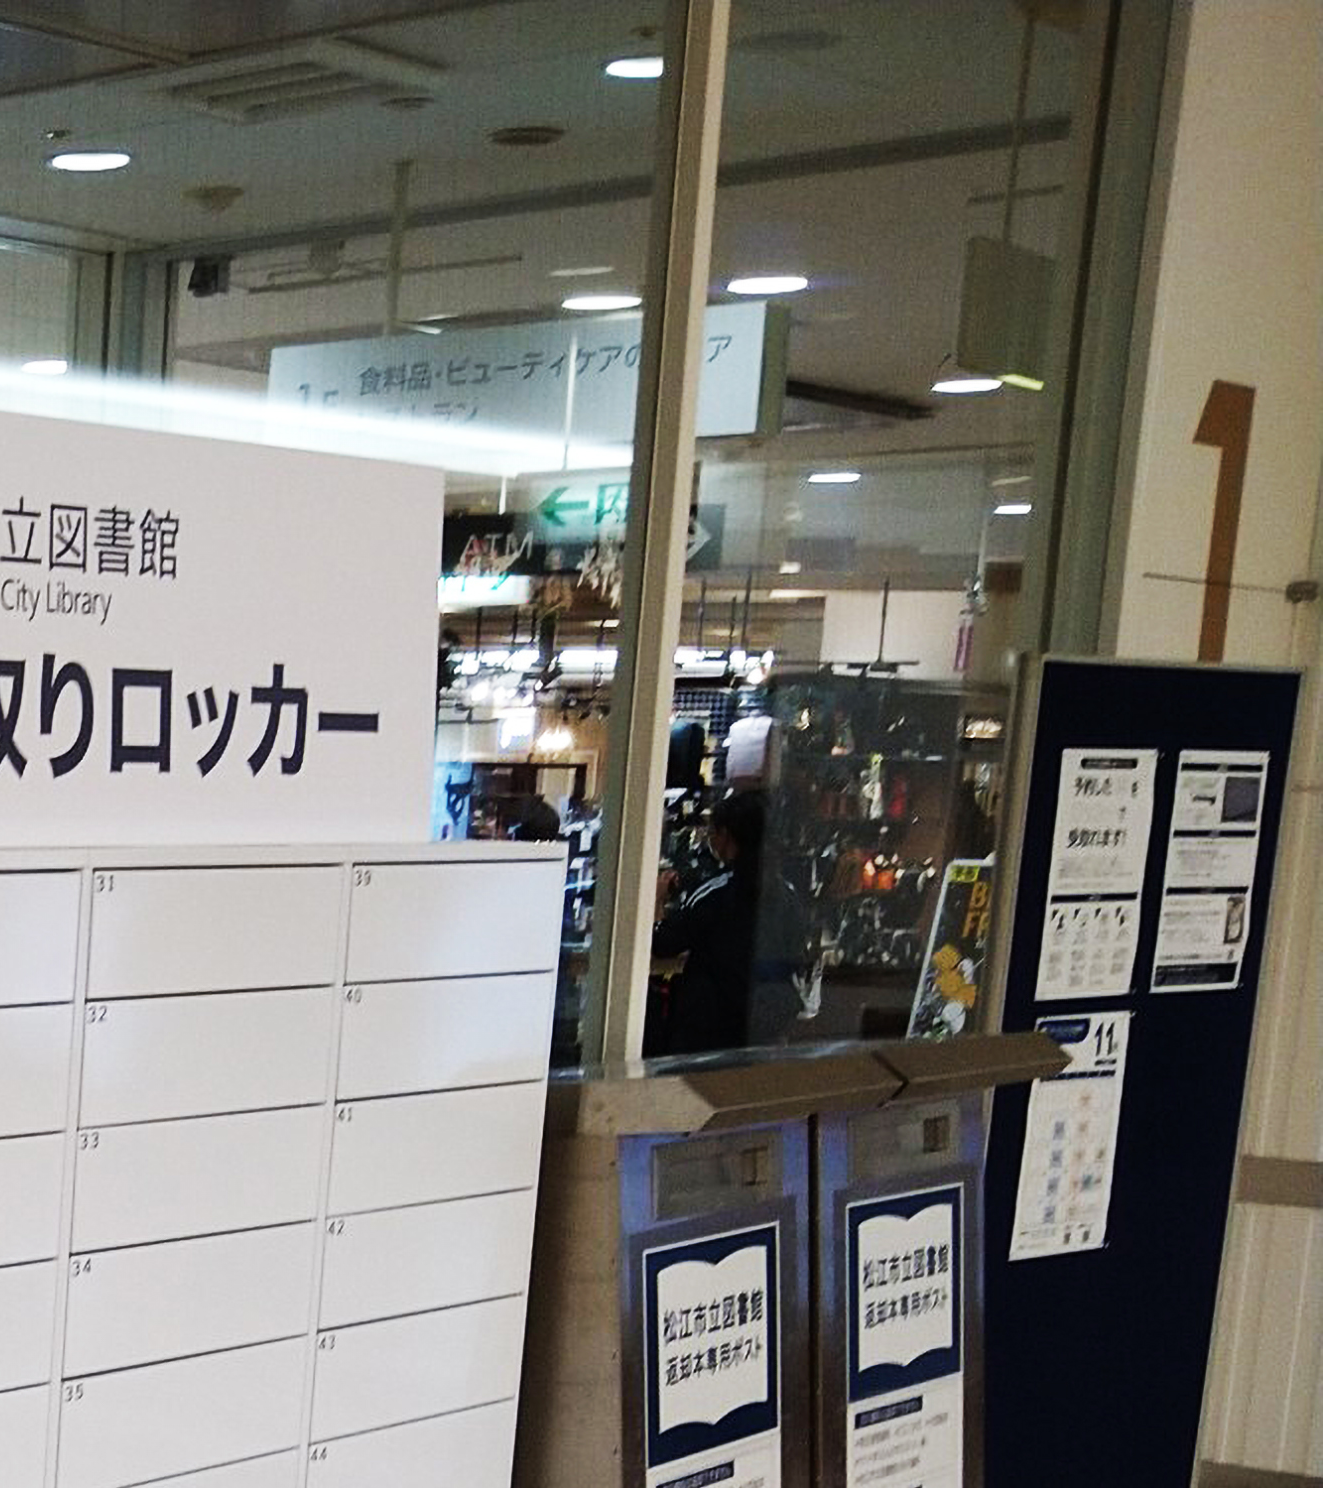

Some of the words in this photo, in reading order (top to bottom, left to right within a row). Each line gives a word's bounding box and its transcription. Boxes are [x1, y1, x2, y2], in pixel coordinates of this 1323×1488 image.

[3, 578, 41, 621] City
[45, 581, 113, 625] Library
[96, 875, 114, 892] 31
[88, 1005, 106, 1022] 32
[80, 1131, 99, 1149] 33
[72, 1259, 91, 1276] 34
[863, 1243, 950, 1292] 松江市立図書館
[663, 1287, 764, 1344] 松江市立図書館
[65, 1385, 83, 1402] 35
